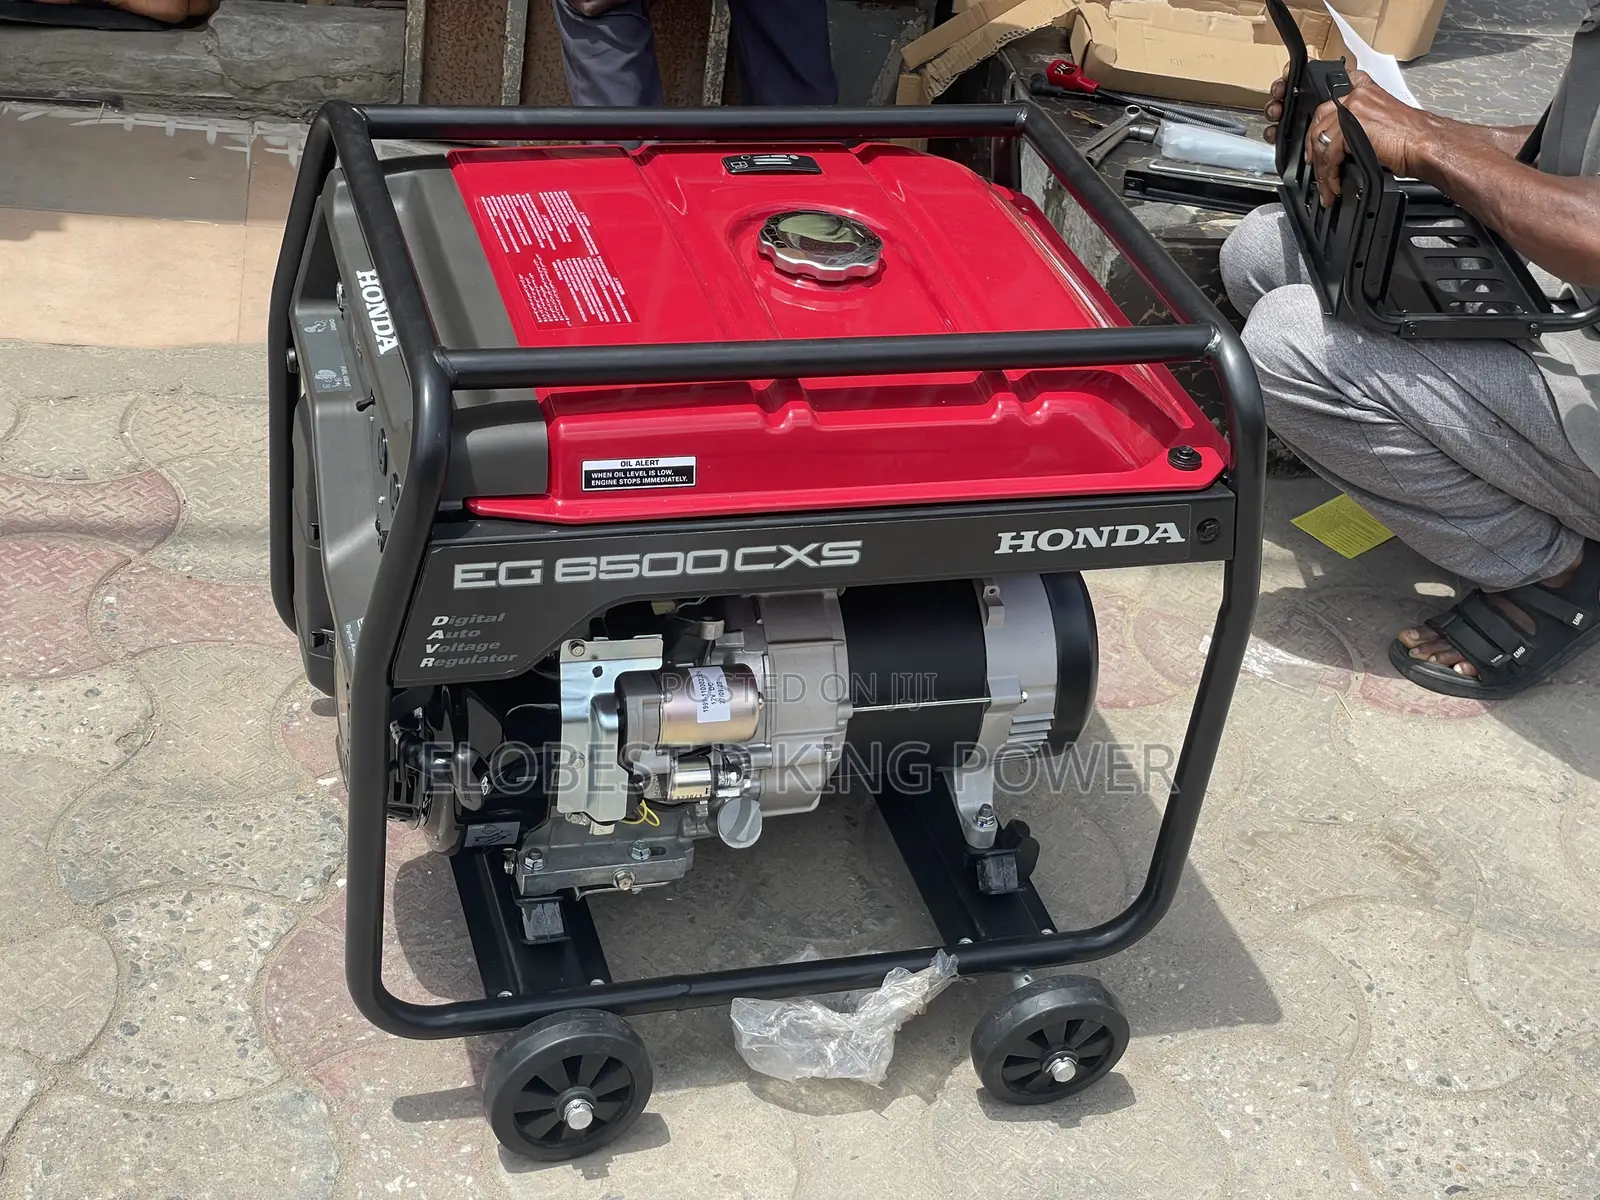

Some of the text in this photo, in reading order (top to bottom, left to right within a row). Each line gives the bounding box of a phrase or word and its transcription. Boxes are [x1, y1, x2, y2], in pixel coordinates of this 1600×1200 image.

[355, 269, 398, 355] HONDA
[635, 459, 660, 467] ALERT
[591, 475, 688, 486] ENGINE STOPS IMMEDIATELY.
[613, 470, 625, 478] OIL
[627, 469, 647, 477] LEVEL
[994, 522, 1185, 554] HONDA
[431, 612, 507, 628] Digital
[427, 628, 482, 640] Auto
[425, 641, 501, 655] Voltage
[420, 654, 518, 668] Regulator
